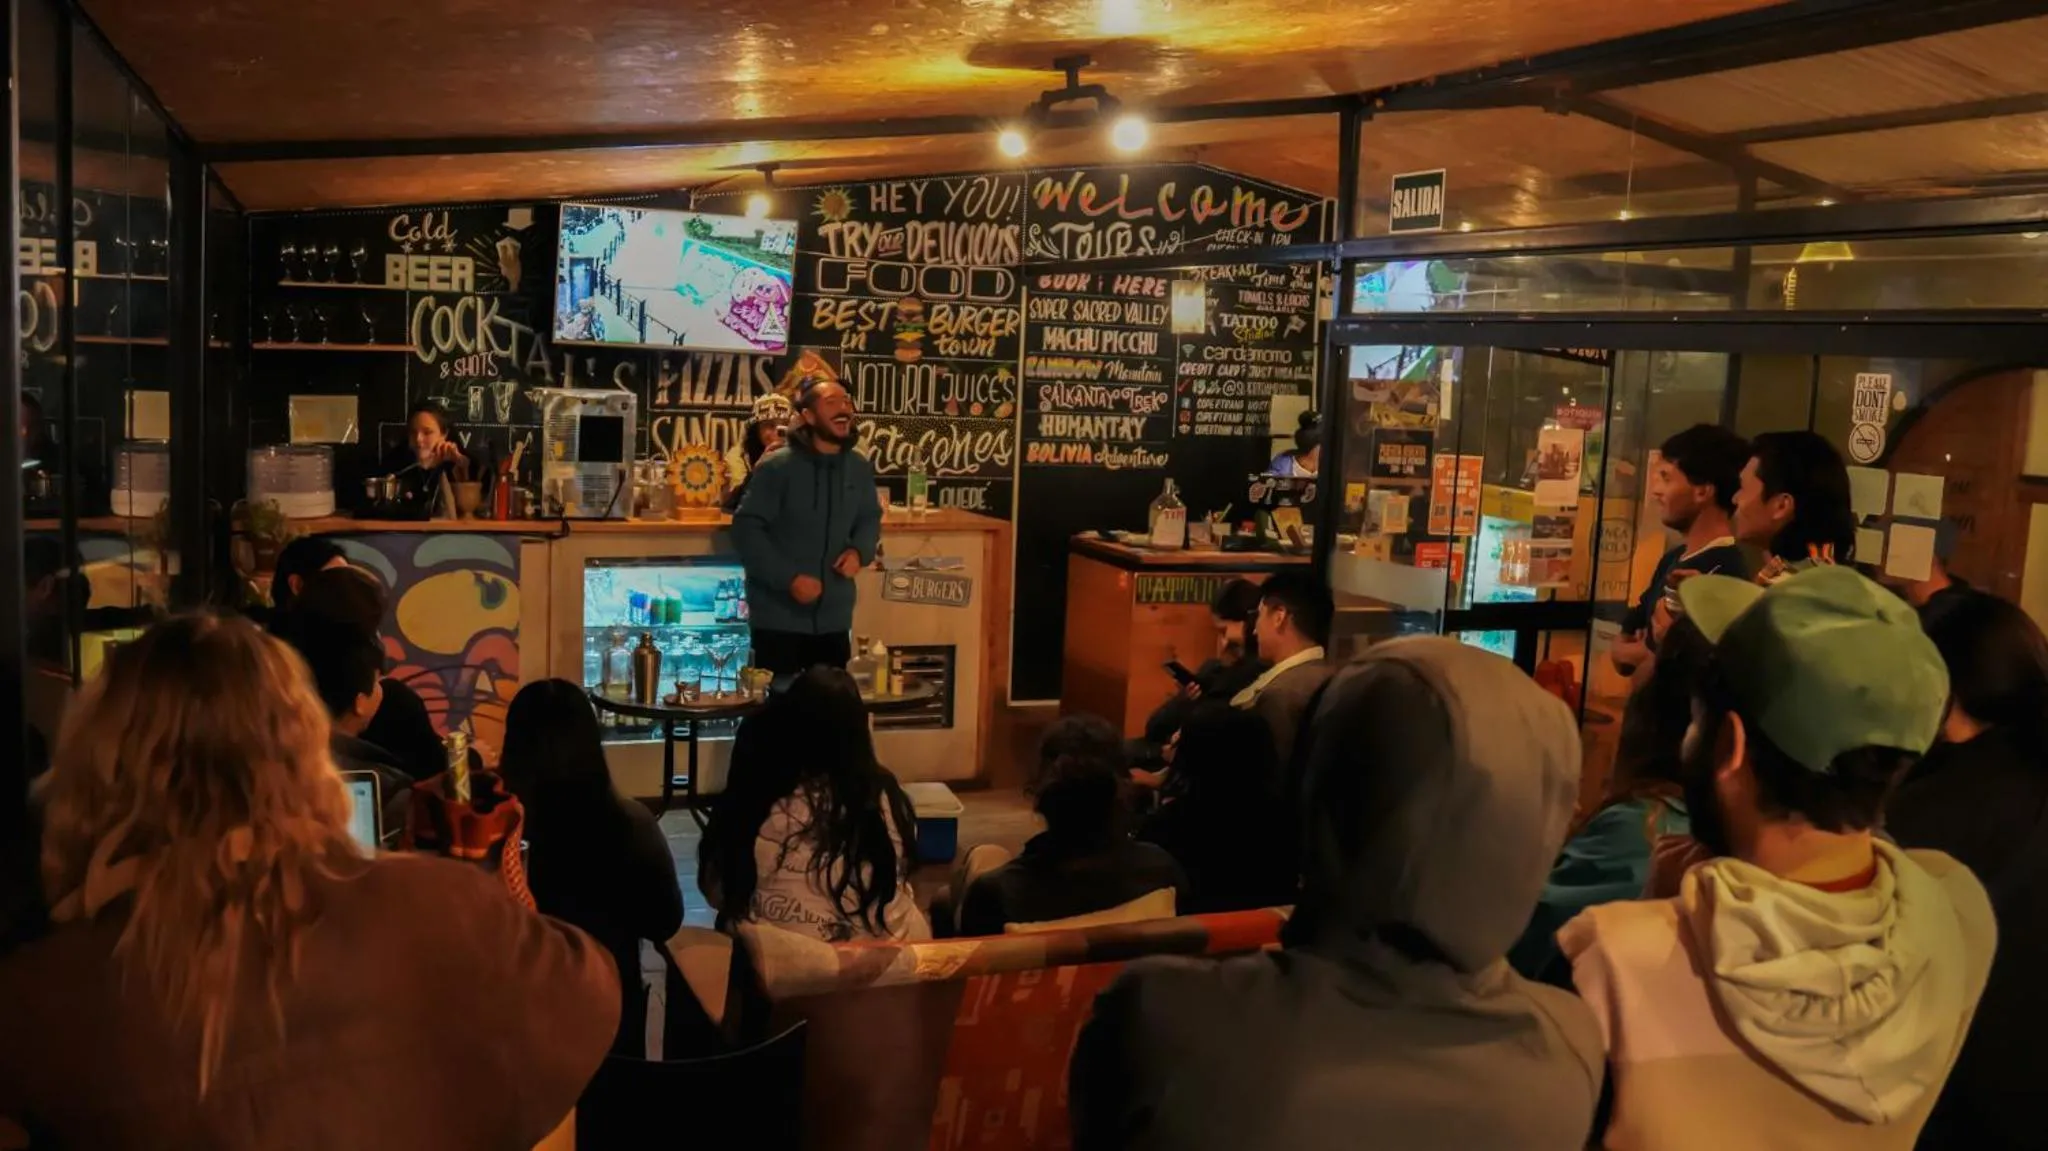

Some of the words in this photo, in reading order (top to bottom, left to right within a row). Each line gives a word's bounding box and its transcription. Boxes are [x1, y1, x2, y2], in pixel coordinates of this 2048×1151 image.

[870, 182, 928, 214] HEY
[943, 176, 1021, 220] YOU!
[1393, 185, 1440, 219] SALIDA
[388, 211, 458, 242] Cold
[816, 221, 884, 258] TRY
[904, 220, 1021, 266] DELICIOUS
[385, 253, 474, 292] BEER
[817, 258, 1016, 300] FOOD
[1113, 274, 1167, 298] HERE
[812, 298, 898, 332] BEST
[928, 304, 1021, 338] BURGER
[1029, 297, 1068, 320] SUPER
[1073, 300, 1122, 324] SACRED
[1124, 302, 1169, 327] VALLEY
[1219, 313, 1279, 329] TATTOO
[841, 330, 867, 350] in
[933, 335, 995, 356] town
[1042, 325, 1101, 352] MACHU
[1102, 330, 1159, 356] PICCHU
[440, 361, 450, 380] &
[453, 351, 498, 378] SHOTS
[844, 361, 943, 416] NATURAL
[942, 372, 1016, 404] JUICES
[1039, 380, 1120, 412] SALKANTAY
[1857, 375, 1887, 389] PLEASE
[1037, 414, 1147, 442] HUMANTAY
[1853, 407, 1884, 423] SMOKE
[1026, 442, 1092, 463] BOLIVIA
[1094, 443, 1168, 470] Adventure
[911, 577, 965, 603] BURGERS
